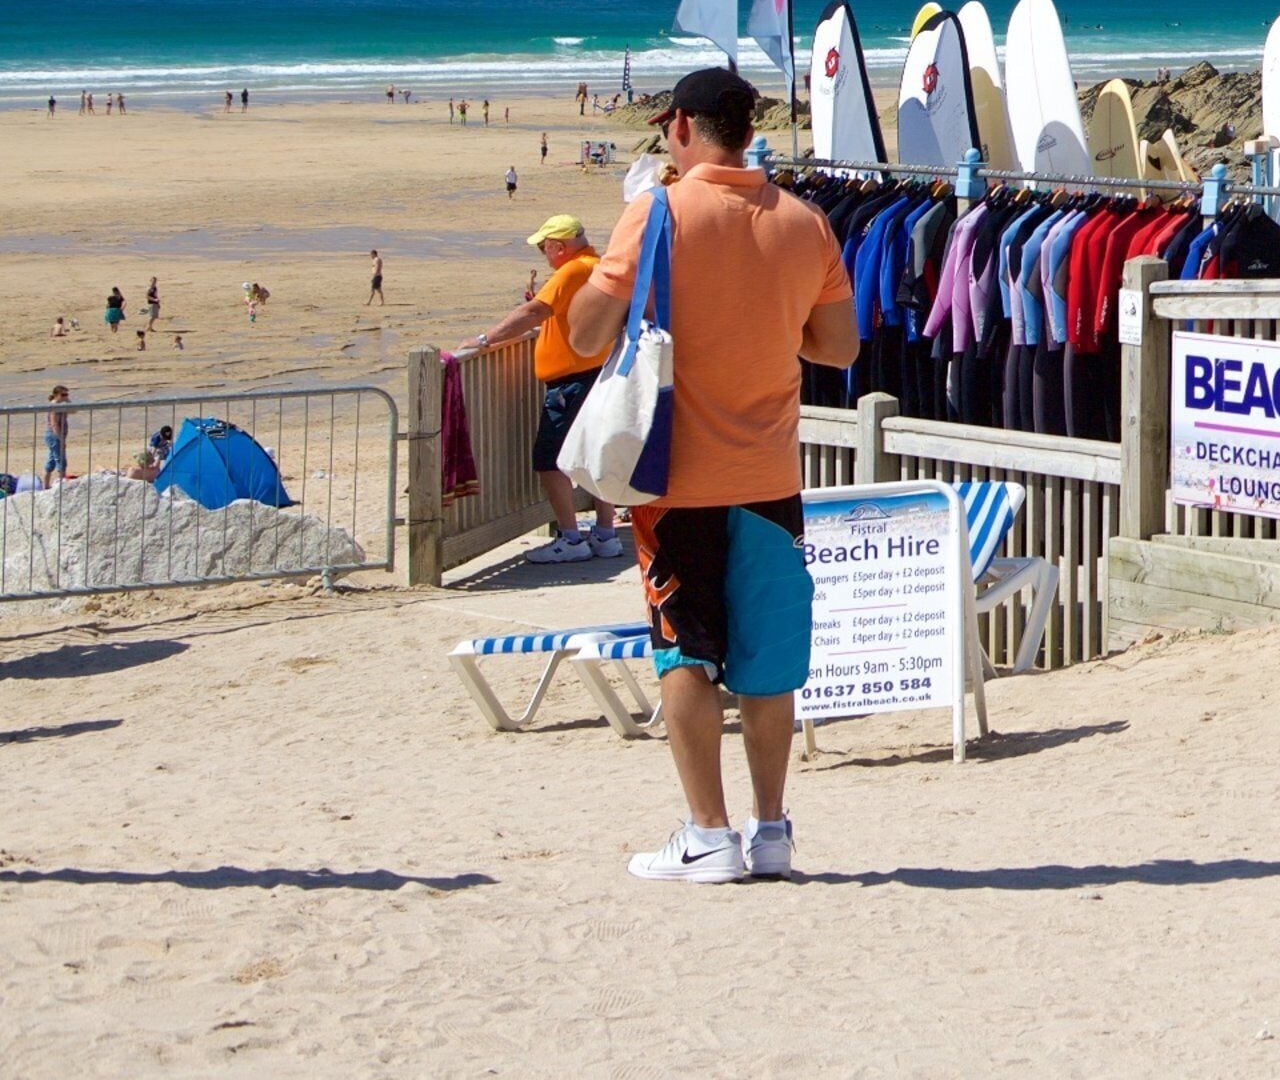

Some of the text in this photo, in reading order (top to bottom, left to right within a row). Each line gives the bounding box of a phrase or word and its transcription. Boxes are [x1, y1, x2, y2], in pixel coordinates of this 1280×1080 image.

[850, 523, 886, 535] Fistral
[803, 536, 940, 565] Beach Hire
[814, 574, 849, 586] oungers
[878, 569, 893, 581] day
[903, 568, 913, 578] £2
[914, 566, 945, 576] deposit
[878, 586, 893, 598] day
[903, 584, 913, 594] £2
[914, 582, 945, 593] deposit
[878, 614, 893, 626] day
[903, 612, 913, 623] £2
[914, 611, 945, 621] deposit
[814, 635, 840, 647] Chairs
[878, 631, 893, 642] day
[902, 628, 913, 639] £2
[914, 627, 945, 638] deposit
[826, 655, 942, 677] Hours 9am 5:30pm
[802, 677, 932, 699] 01637 850 584
[801, 693, 932, 711] www.fistralbeach.co.uk
